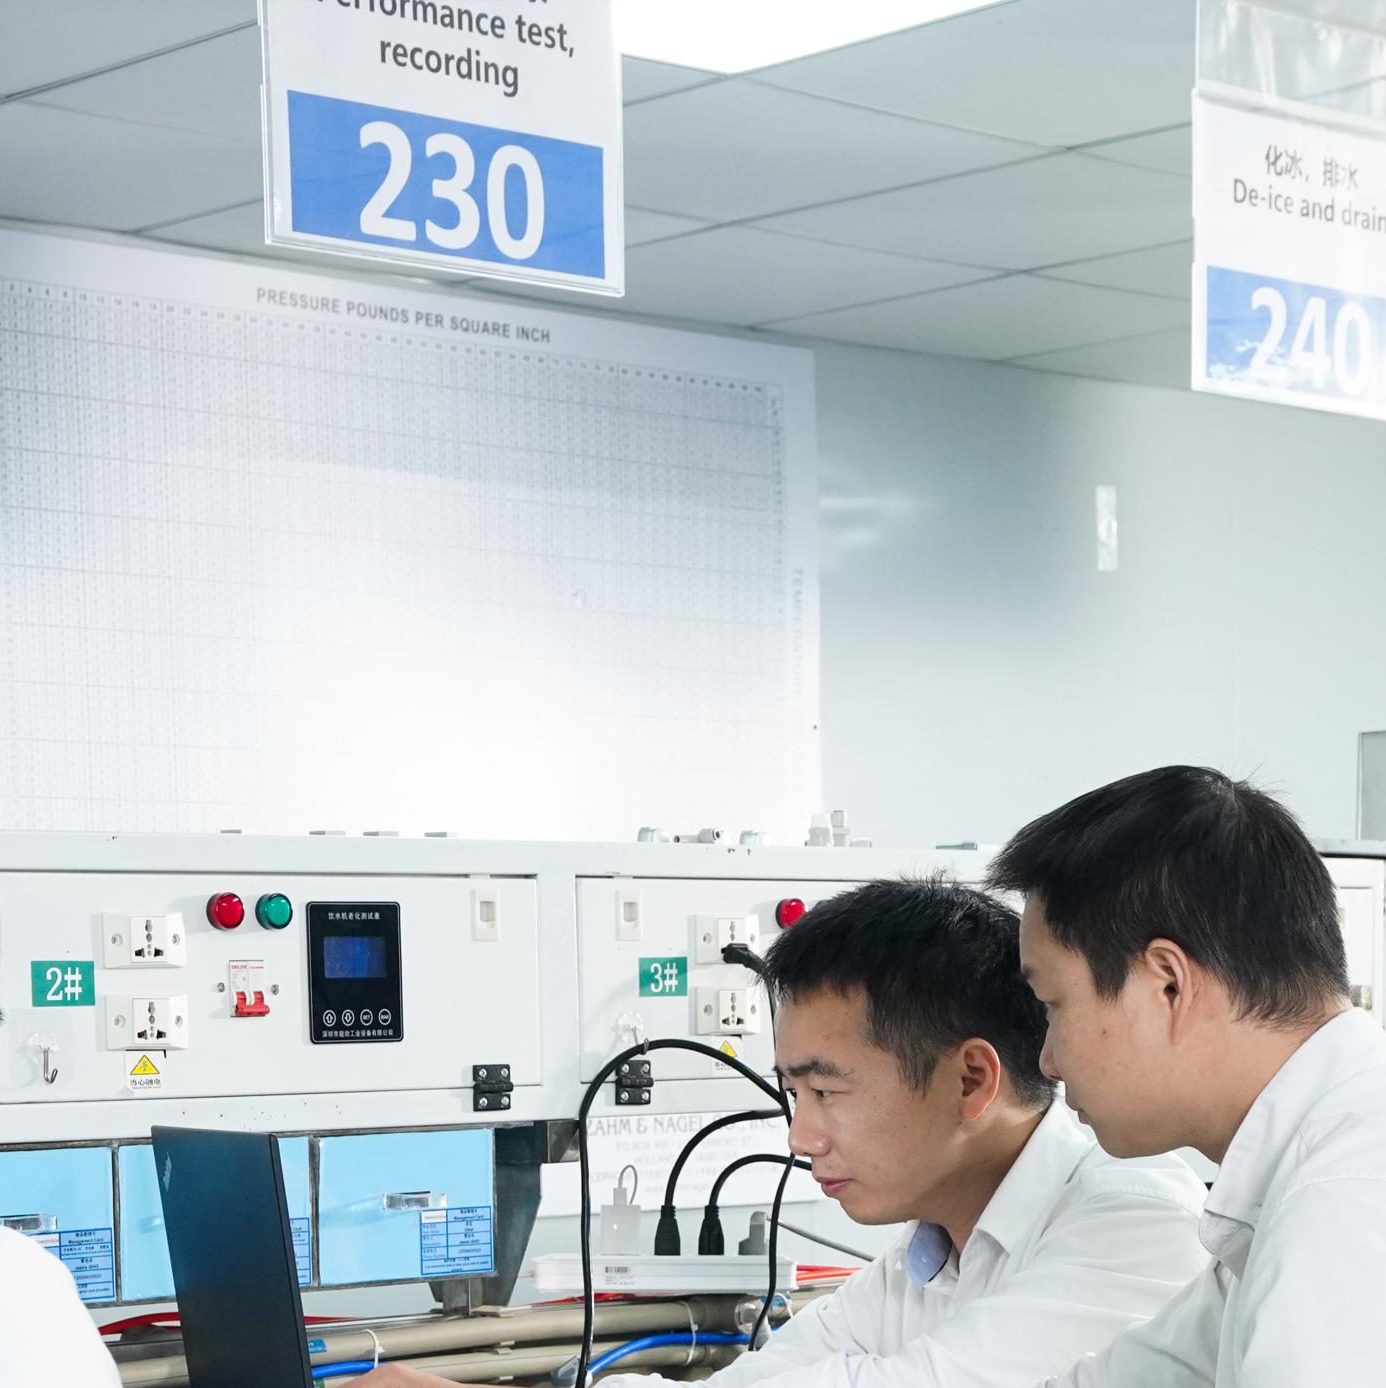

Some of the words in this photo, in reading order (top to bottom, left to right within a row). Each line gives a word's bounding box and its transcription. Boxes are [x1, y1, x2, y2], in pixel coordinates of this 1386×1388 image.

[515, 14, 575, 58] test,
[379, 40, 519, 97] recording
[359, 121, 545, 260] 230
[1233, 178, 1294, 214] De-ice
[1300, 199, 1334, 222] and
[256, 287, 341, 314] PRESSURE
[346, 301, 410, 324] POUNDS
[415, 311, 445, 329] PER
[450, 315, 511, 338] SQUARE
[515, 326, 551, 344] INCH
[1249, 286, 1371, 396] 240
[46, 967, 83, 1001] 2#
[650, 963, 678, 993] 3#
[587, 1118, 632, 1136] ZAHM
[636, 1117, 648, 1134] &
